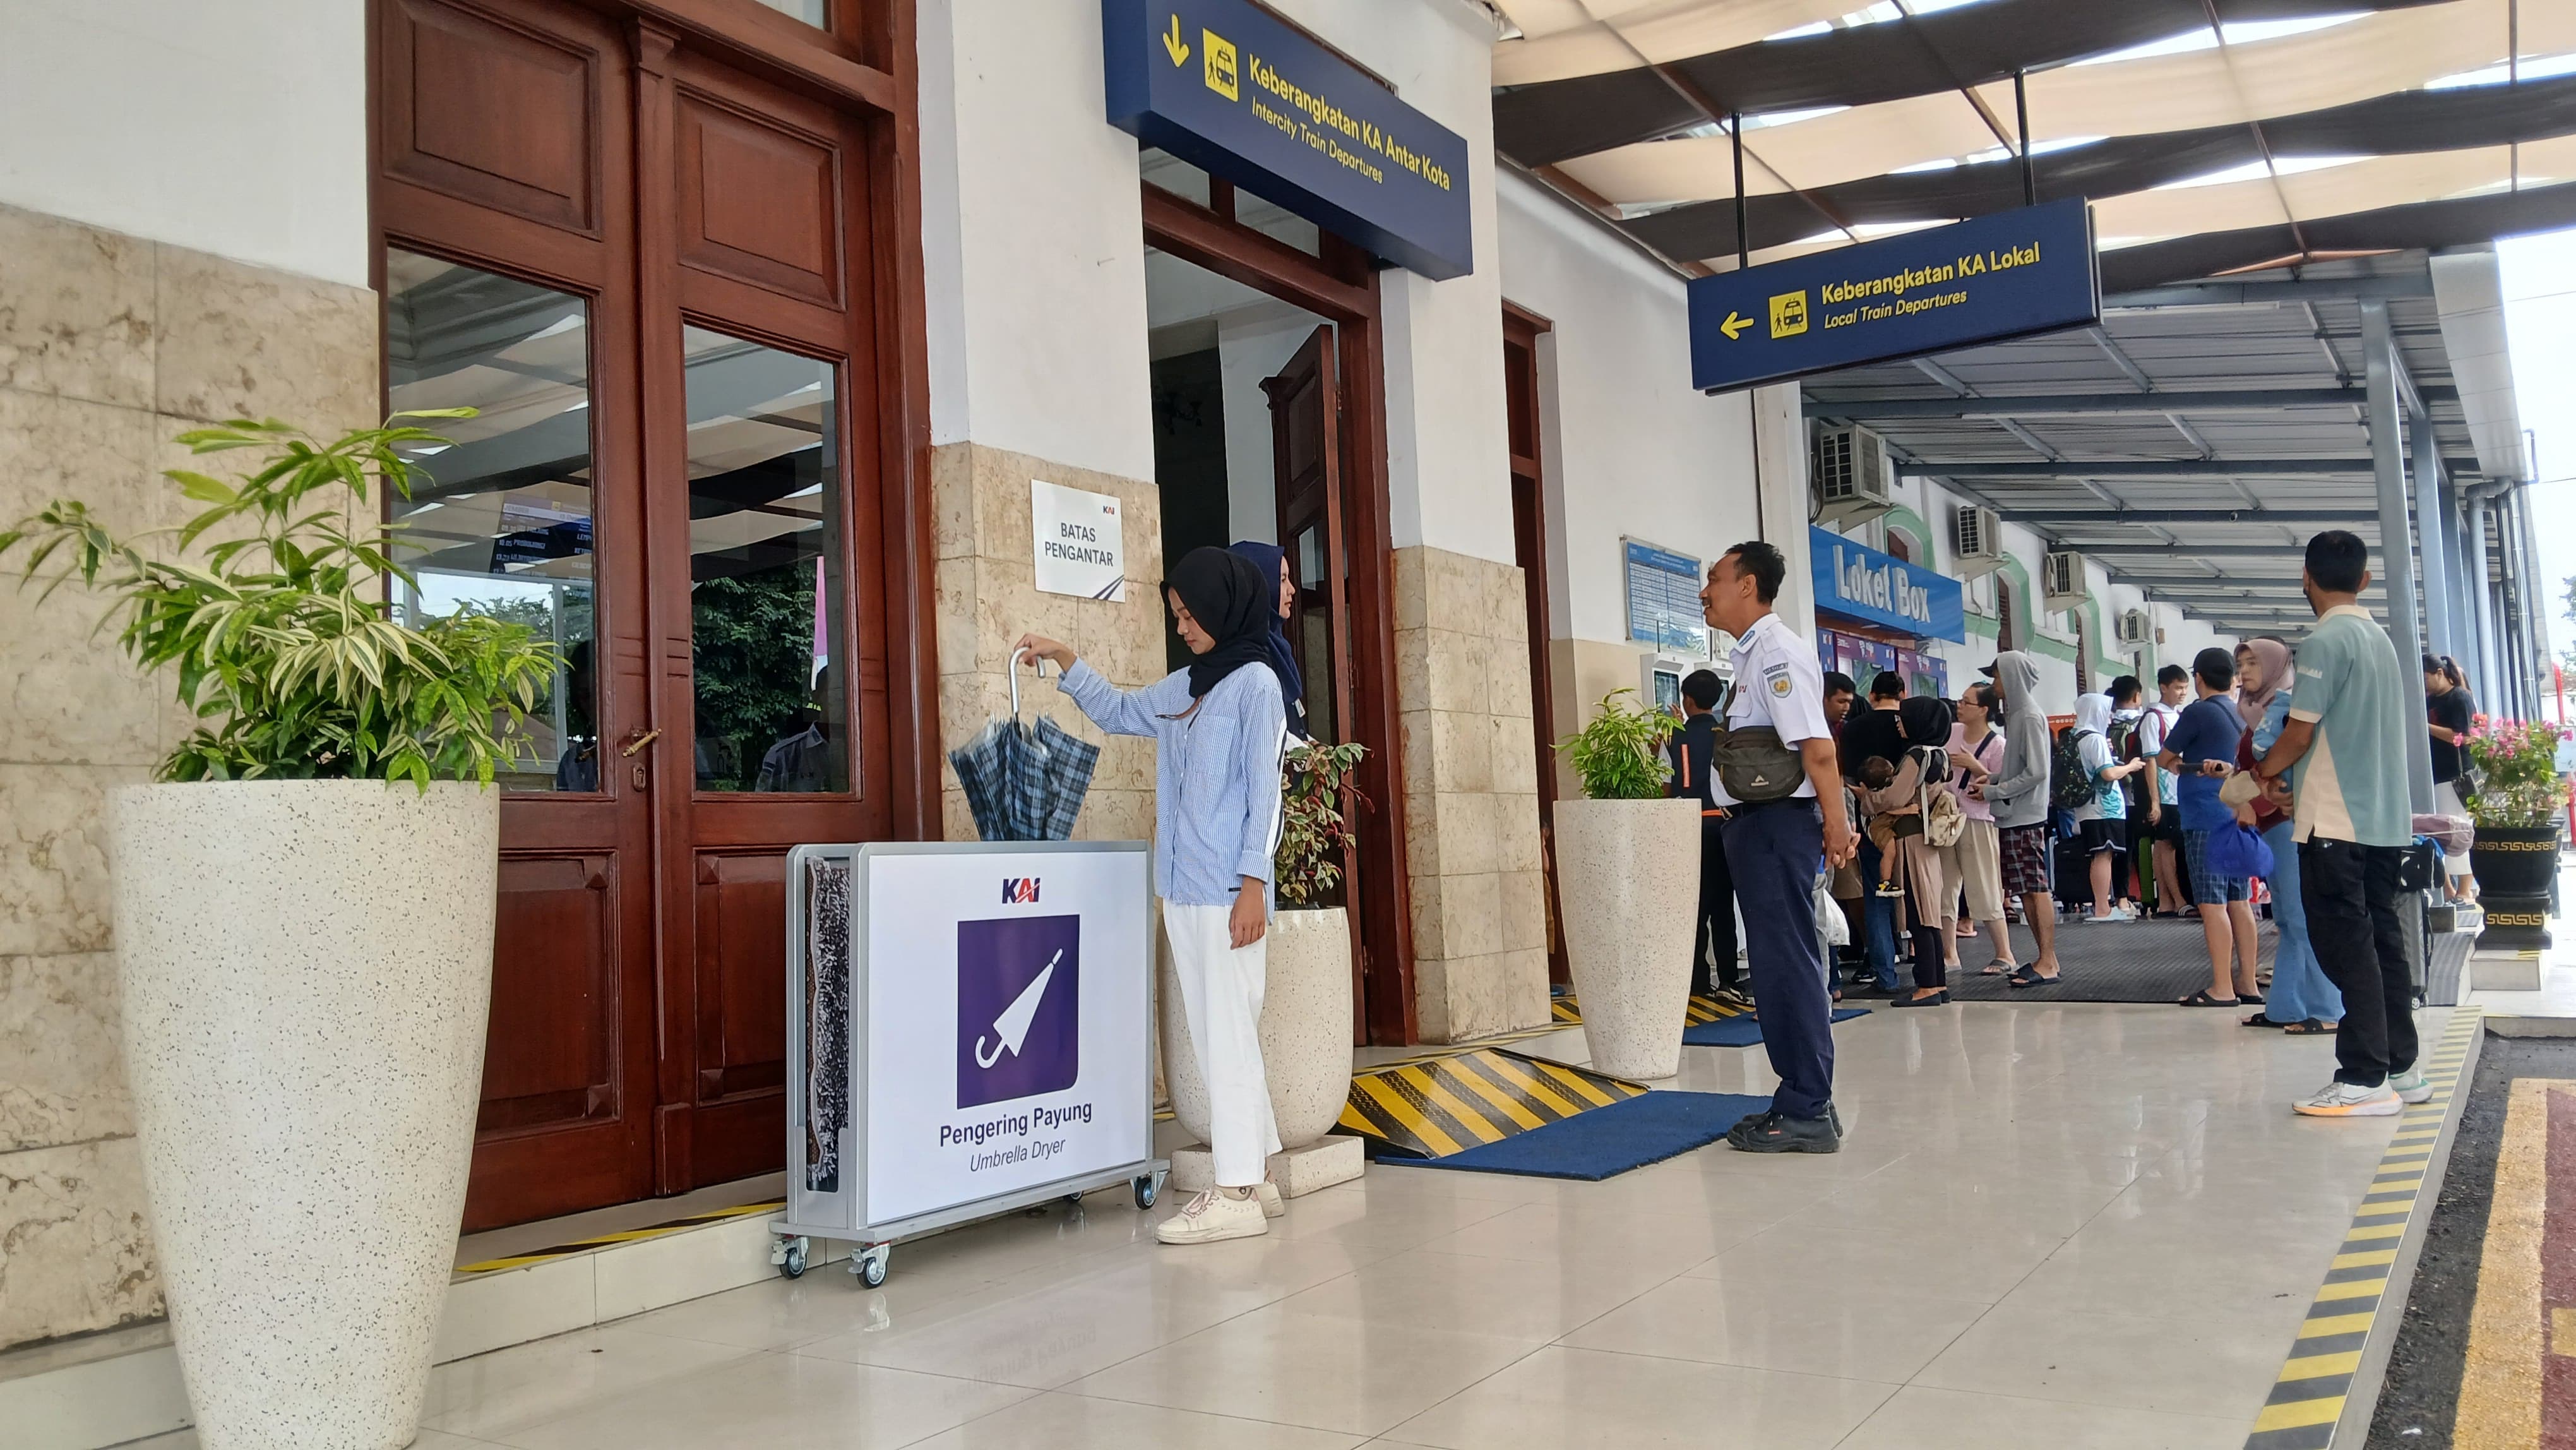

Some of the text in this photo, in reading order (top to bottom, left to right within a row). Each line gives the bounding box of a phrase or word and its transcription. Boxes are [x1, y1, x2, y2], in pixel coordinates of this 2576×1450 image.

[1248, 53, 1450, 191] Keberangkatan KA Antar Kota
[1252, 96, 1383, 184] Intercity Train Departures
[1822, 242, 2041, 306] Keberangkatan KA Lokal
[1824, 291, 1967, 329] Local Train Departures
[1102, 505, 1115, 515] KAI
[1061, 522, 1096, 542] BATAS
[1045, 541, 1113, 566] PENGANTAR
[1833, 545, 1931, 623] Loket Box
[1001, 877, 1041, 904] KAI
[940, 1103, 1092, 1147] Pengering Payung
[970, 1139, 1066, 1172] Umbrella Dryer
